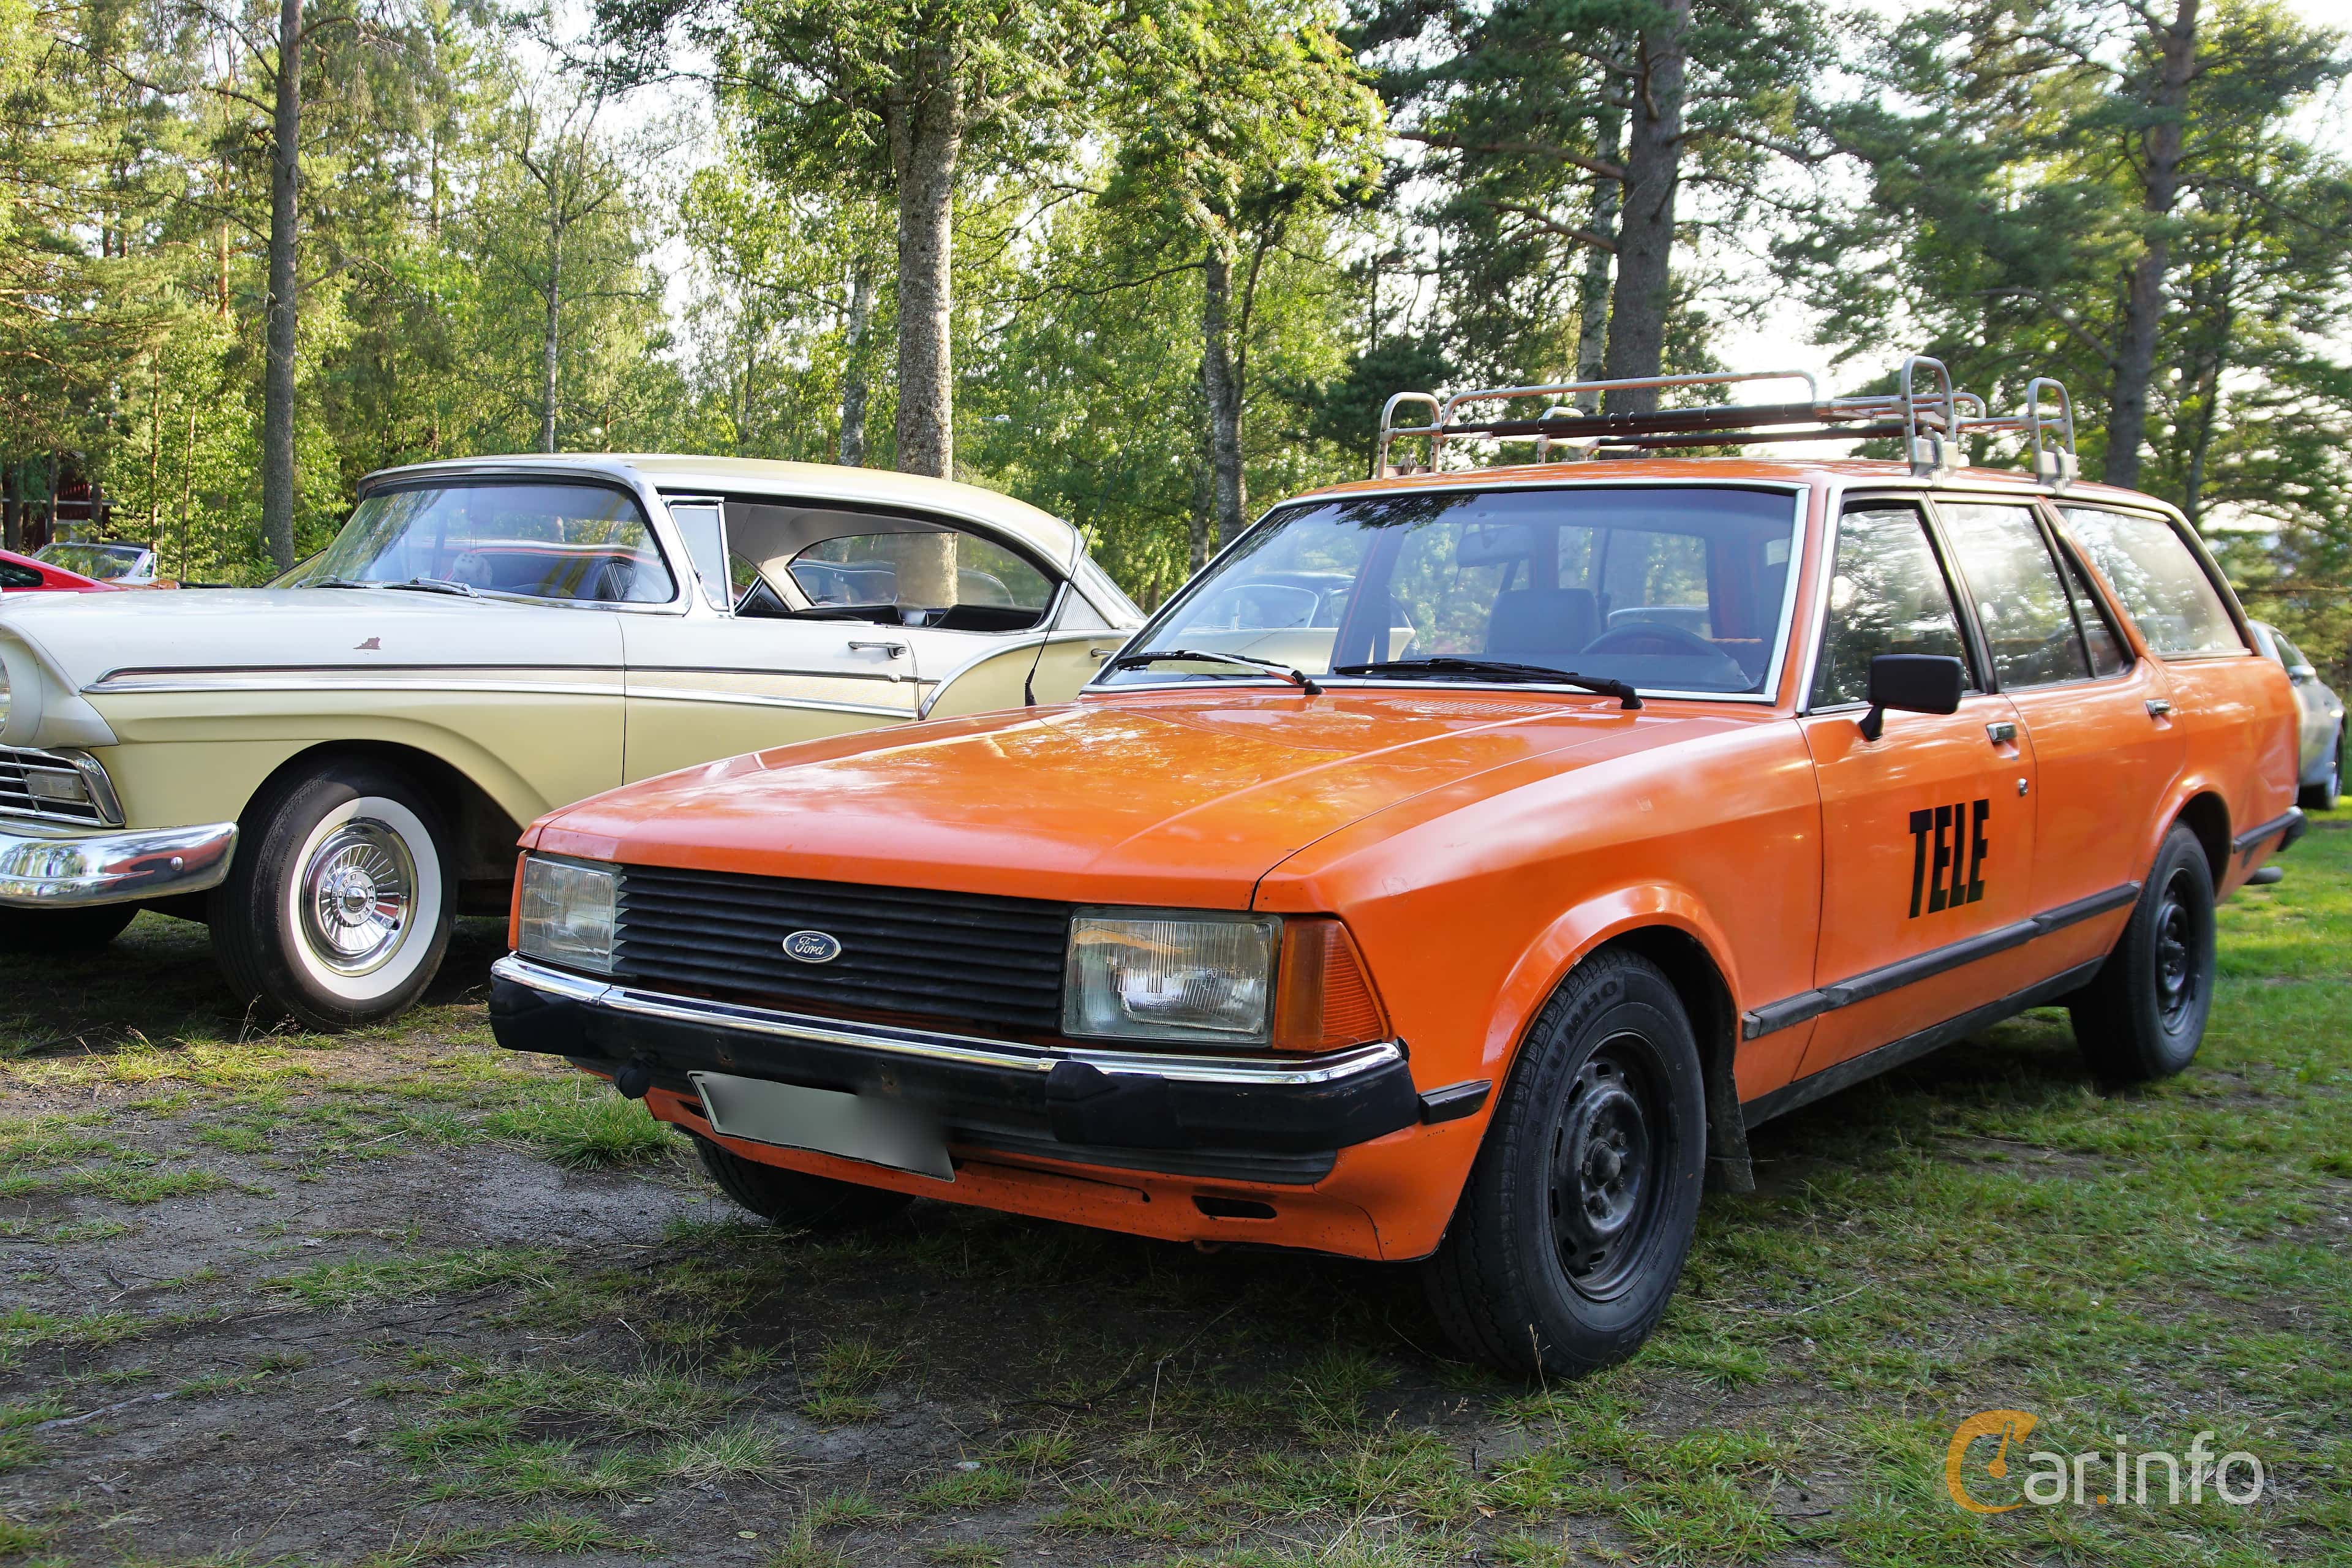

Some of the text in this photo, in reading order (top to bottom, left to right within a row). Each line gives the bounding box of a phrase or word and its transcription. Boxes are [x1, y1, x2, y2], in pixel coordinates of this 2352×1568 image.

[1909, 799, 1989, 919] TELE
[795, 937, 826, 955] Ford
[1538, 979, 1619, 1102] KUMHO
